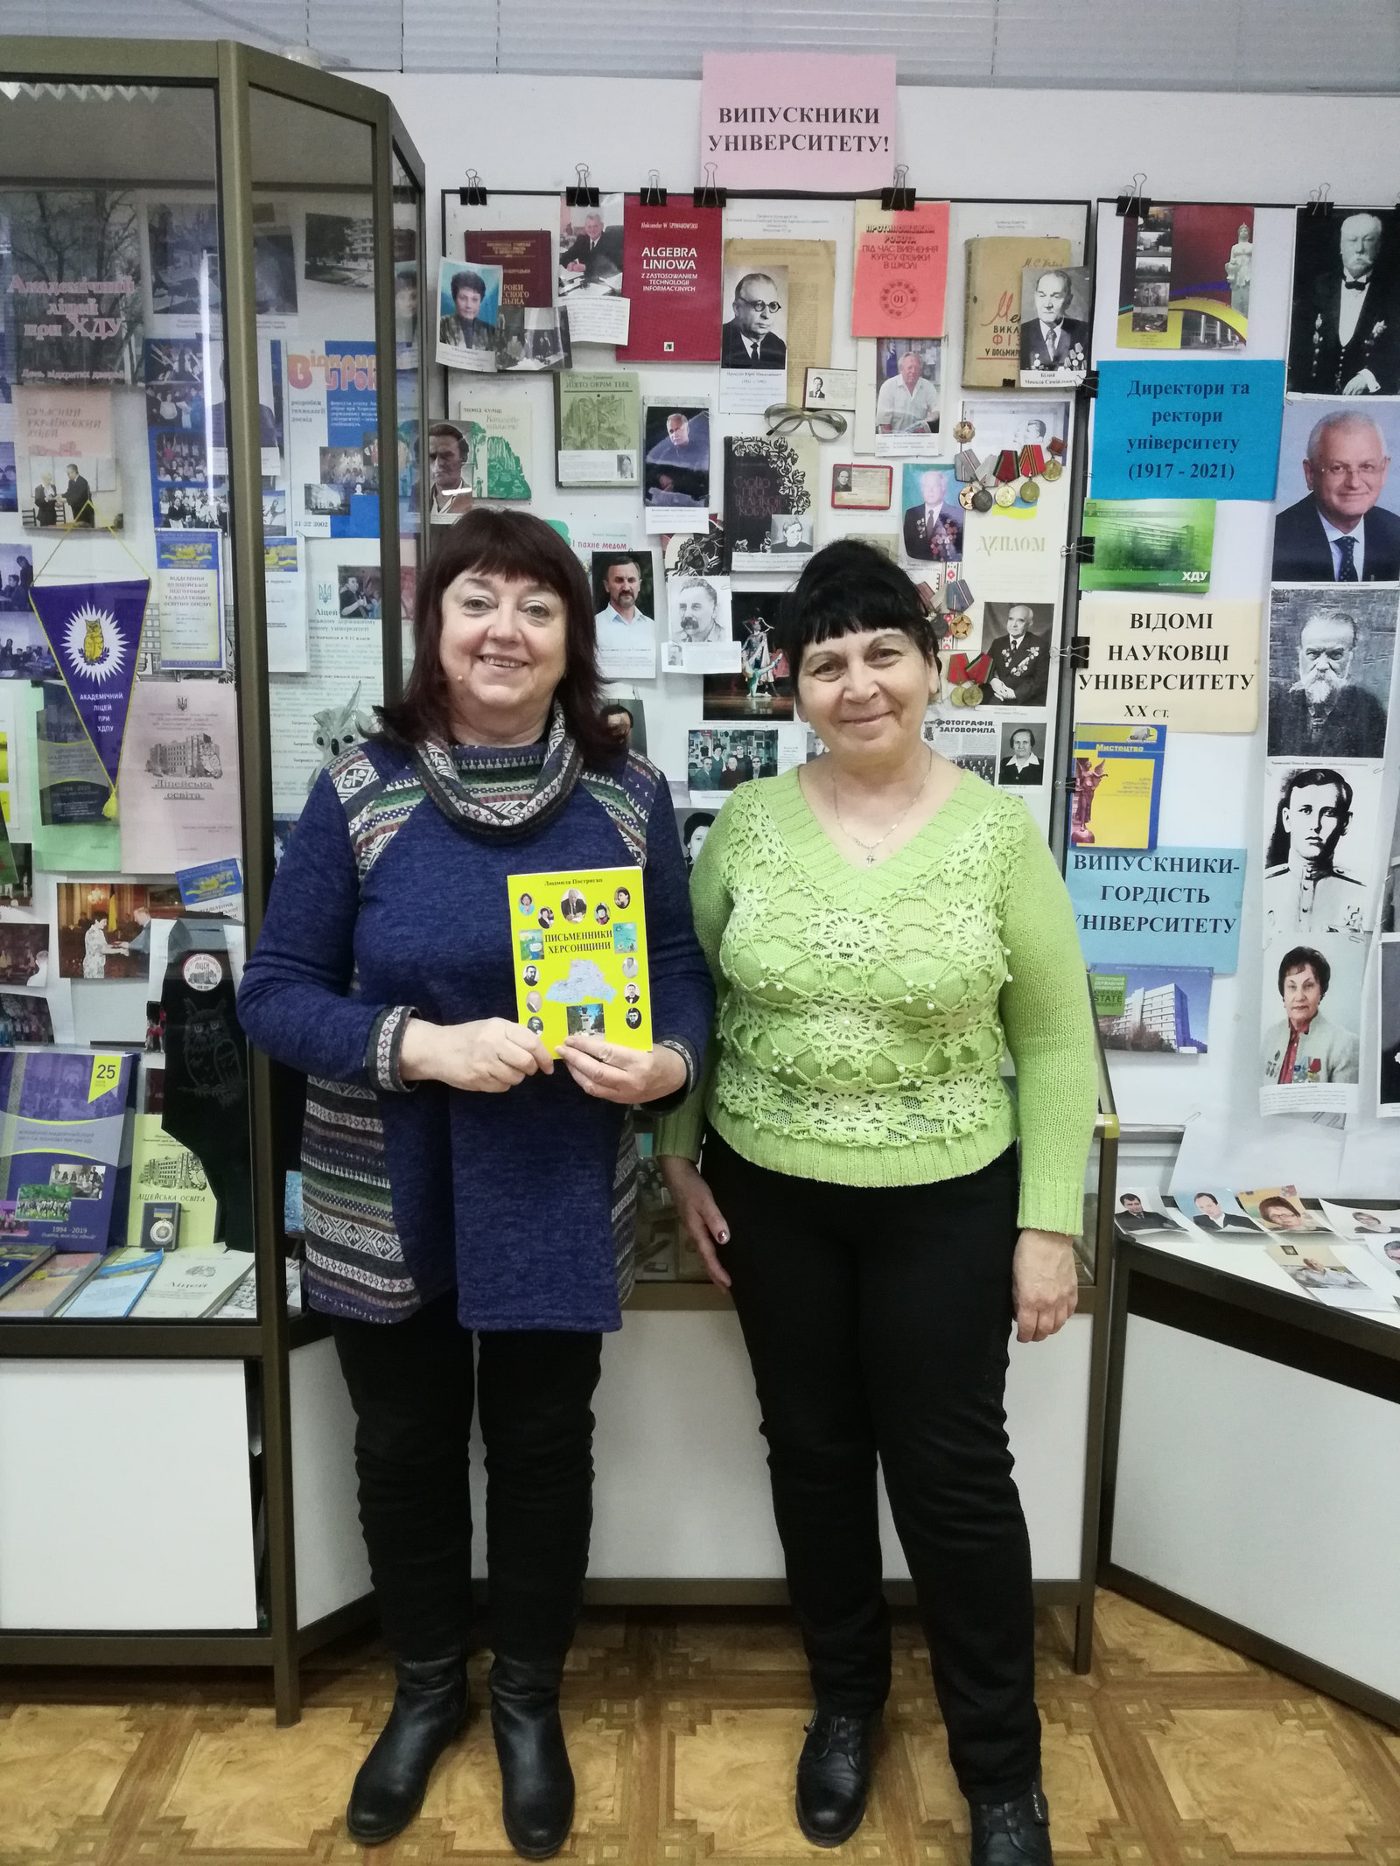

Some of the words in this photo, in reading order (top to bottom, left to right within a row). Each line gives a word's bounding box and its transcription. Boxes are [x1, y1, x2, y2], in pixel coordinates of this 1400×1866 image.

[719, 106, 880, 124] ВИПУСКНИКИ
[708, 134, 889, 152] УНІВЕРСИТЕТУ!
[641, 247, 697, 257] ALGEBRA
[878, 245, 894, 253] ЧАС
[896, 245, 939, 253] ВИВЧЕННЯ
[643, 259, 696, 270] LINIOWA
[891, 262, 917, 270] ШКОЛІ
[66, 313, 125, 340] ХДУ
[993, 325, 1020, 334] ВИКЛ
[1126, 380, 1225, 399] Директори
[1230, 382, 1250, 395] та
[1151, 410, 1223, 427] ректори
[1126, 434, 1240, 453] університету
[1128, 463, 1174, 481] (1917
[1190, 463, 1235, 481] 2021)
[578, 541, 600, 549] пахне
[602, 542, 627, 550] медом
[1181, 571, 1208, 583] ХДУ
[1130, 613, 1213, 632] ВІДОМІ
[1108, 645, 1229, 664] НАУКОВЦІ
[1078, 674, 1256, 691] УНІВЕРСИТЕТУ
[93, 703, 112, 711] ЛІЦЕЙ
[97, 725, 114, 733] ХДПУ
[1095, 743, 1144, 752] Мистецтво
[1074, 854, 1240, 874] ВИПУСКНИКИ-
[1101, 885, 1211, 905] ГОРДІСТЬ
[545, 930, 612, 942] ПИСЬМЕННИКИ
[548, 942, 611, 954] ХЕРСОНЩИНИ
[96, 1064, 116, 1079] 25
[72, 1226, 88, 1234] 2019
